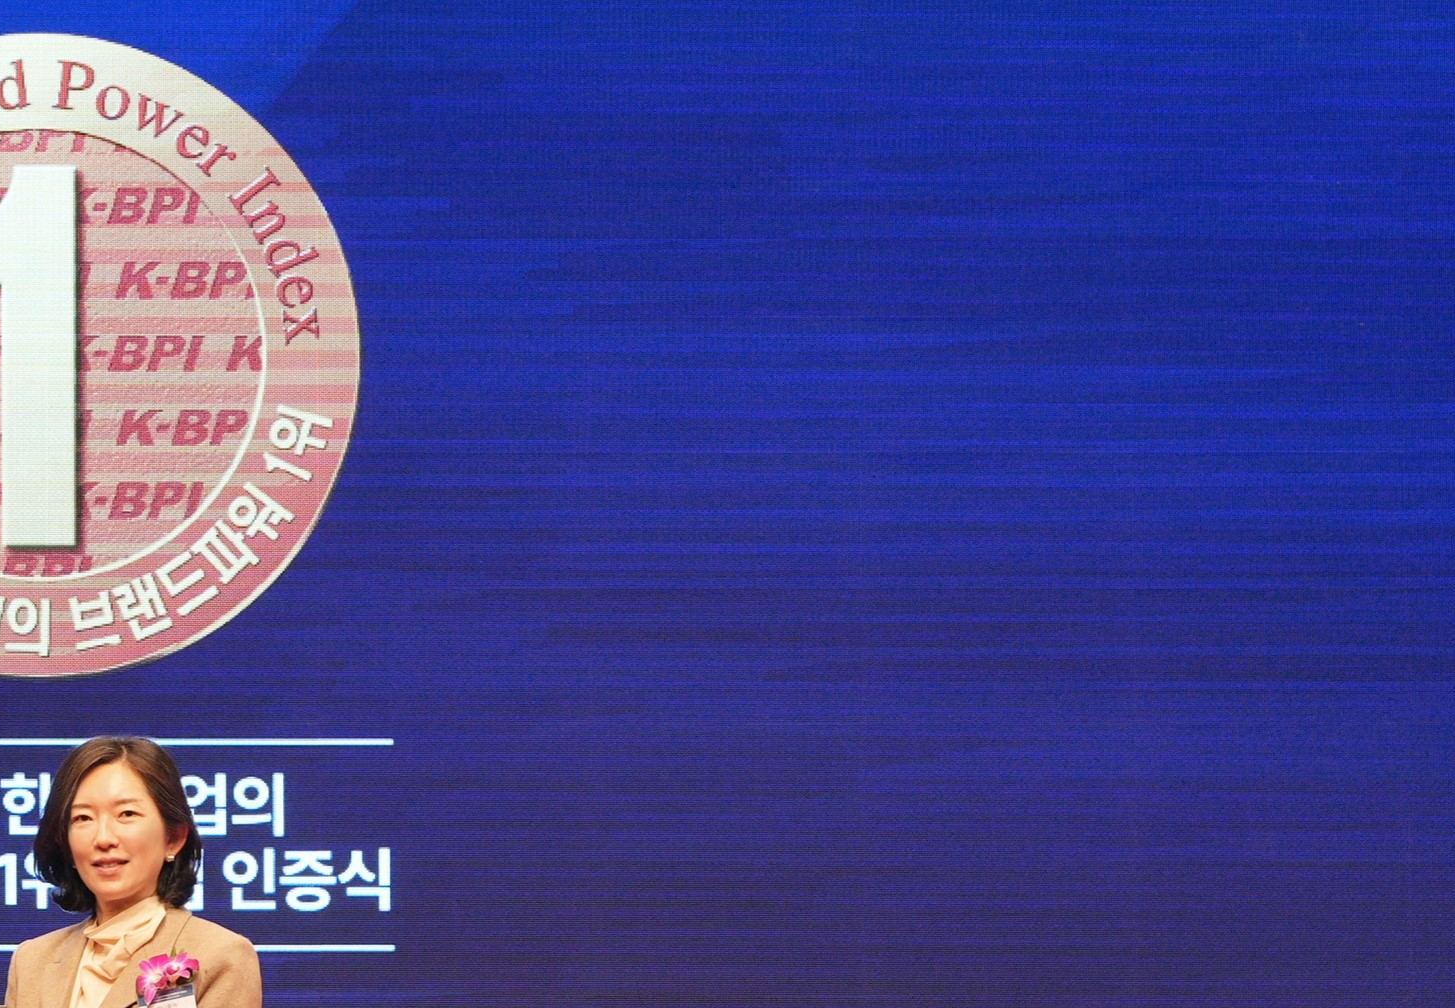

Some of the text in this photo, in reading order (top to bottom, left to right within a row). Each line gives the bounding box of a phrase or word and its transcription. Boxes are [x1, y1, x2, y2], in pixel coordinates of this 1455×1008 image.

[52, 59, 237, 178] Power
[228, 166, 320, 347] Index
[73, 480, 296, 652] 브랜드파워
[263, 403, 335, 482] 1위
[223, 846, 392, 912] 인증식
